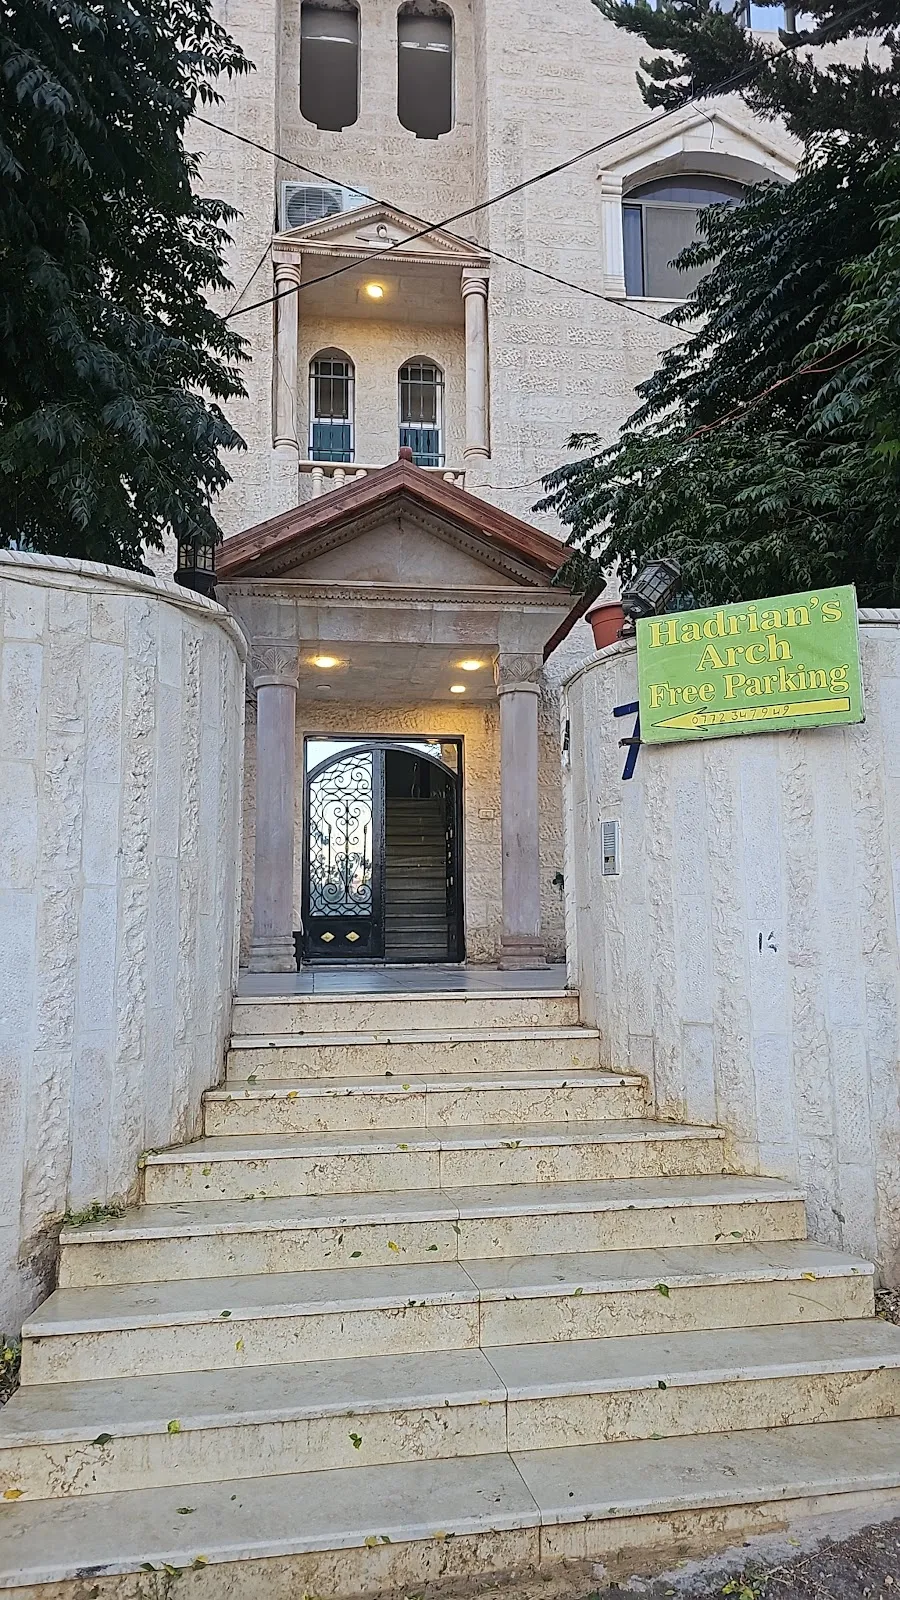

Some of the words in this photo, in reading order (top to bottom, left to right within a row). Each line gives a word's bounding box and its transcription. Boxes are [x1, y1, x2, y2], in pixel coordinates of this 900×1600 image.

[648, 597, 842, 649] Hadrian's
[696, 634, 792, 672] Arch
[648, 681, 716, 708] Free
[723, 664, 849, 694] Parking
